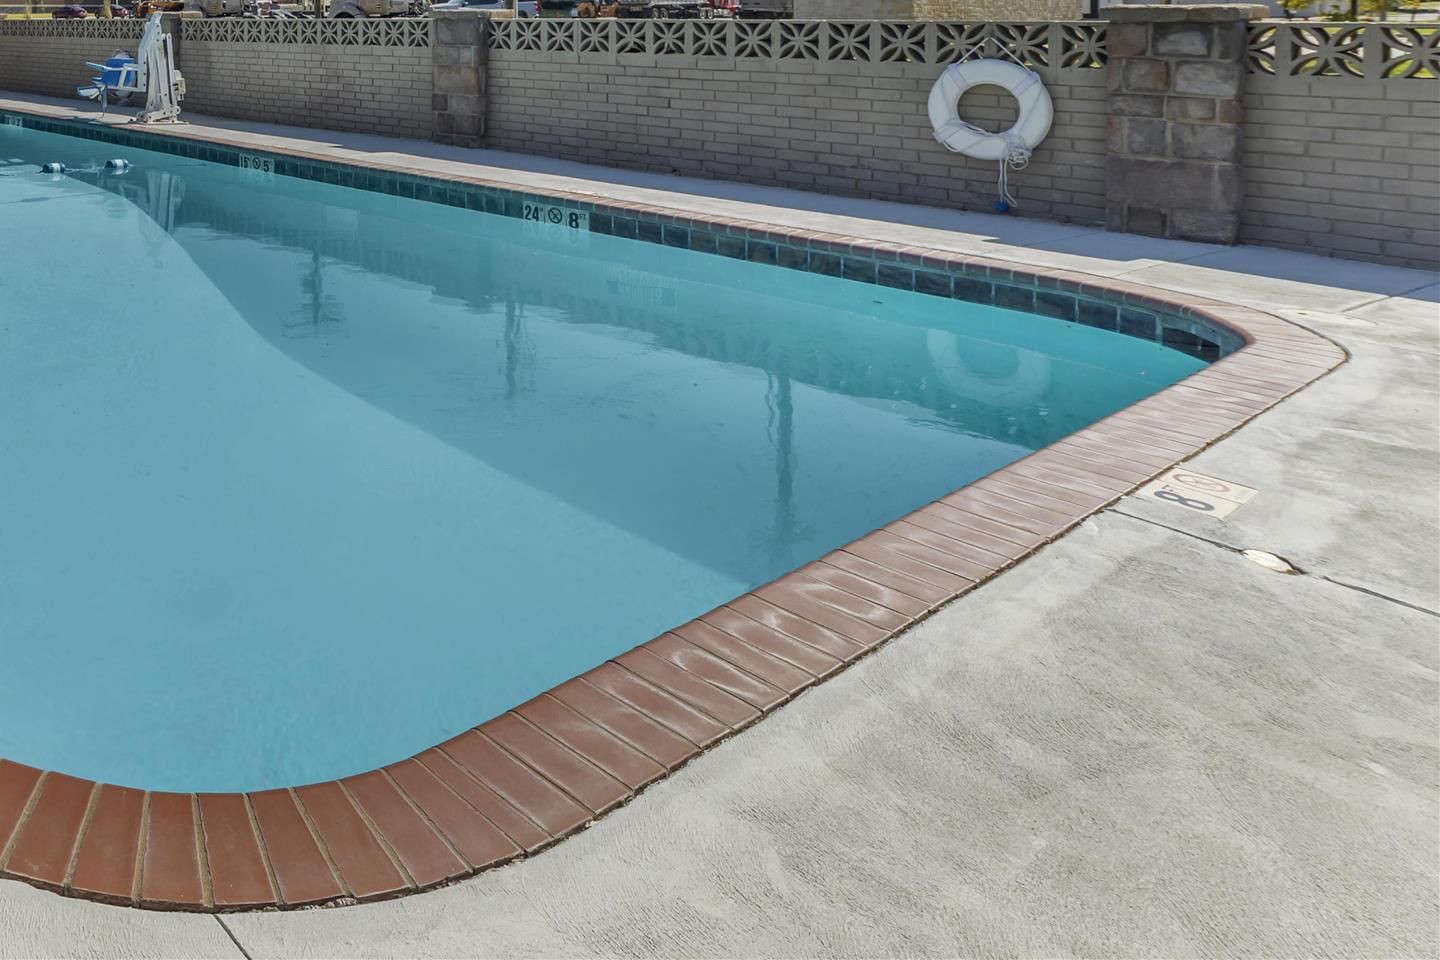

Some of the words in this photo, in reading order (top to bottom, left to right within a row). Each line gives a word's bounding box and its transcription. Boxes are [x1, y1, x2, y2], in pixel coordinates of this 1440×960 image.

[263, 160, 269, 172] 5
[568, 212, 579, 228] 8
[1153, 490, 1215, 511] 8
